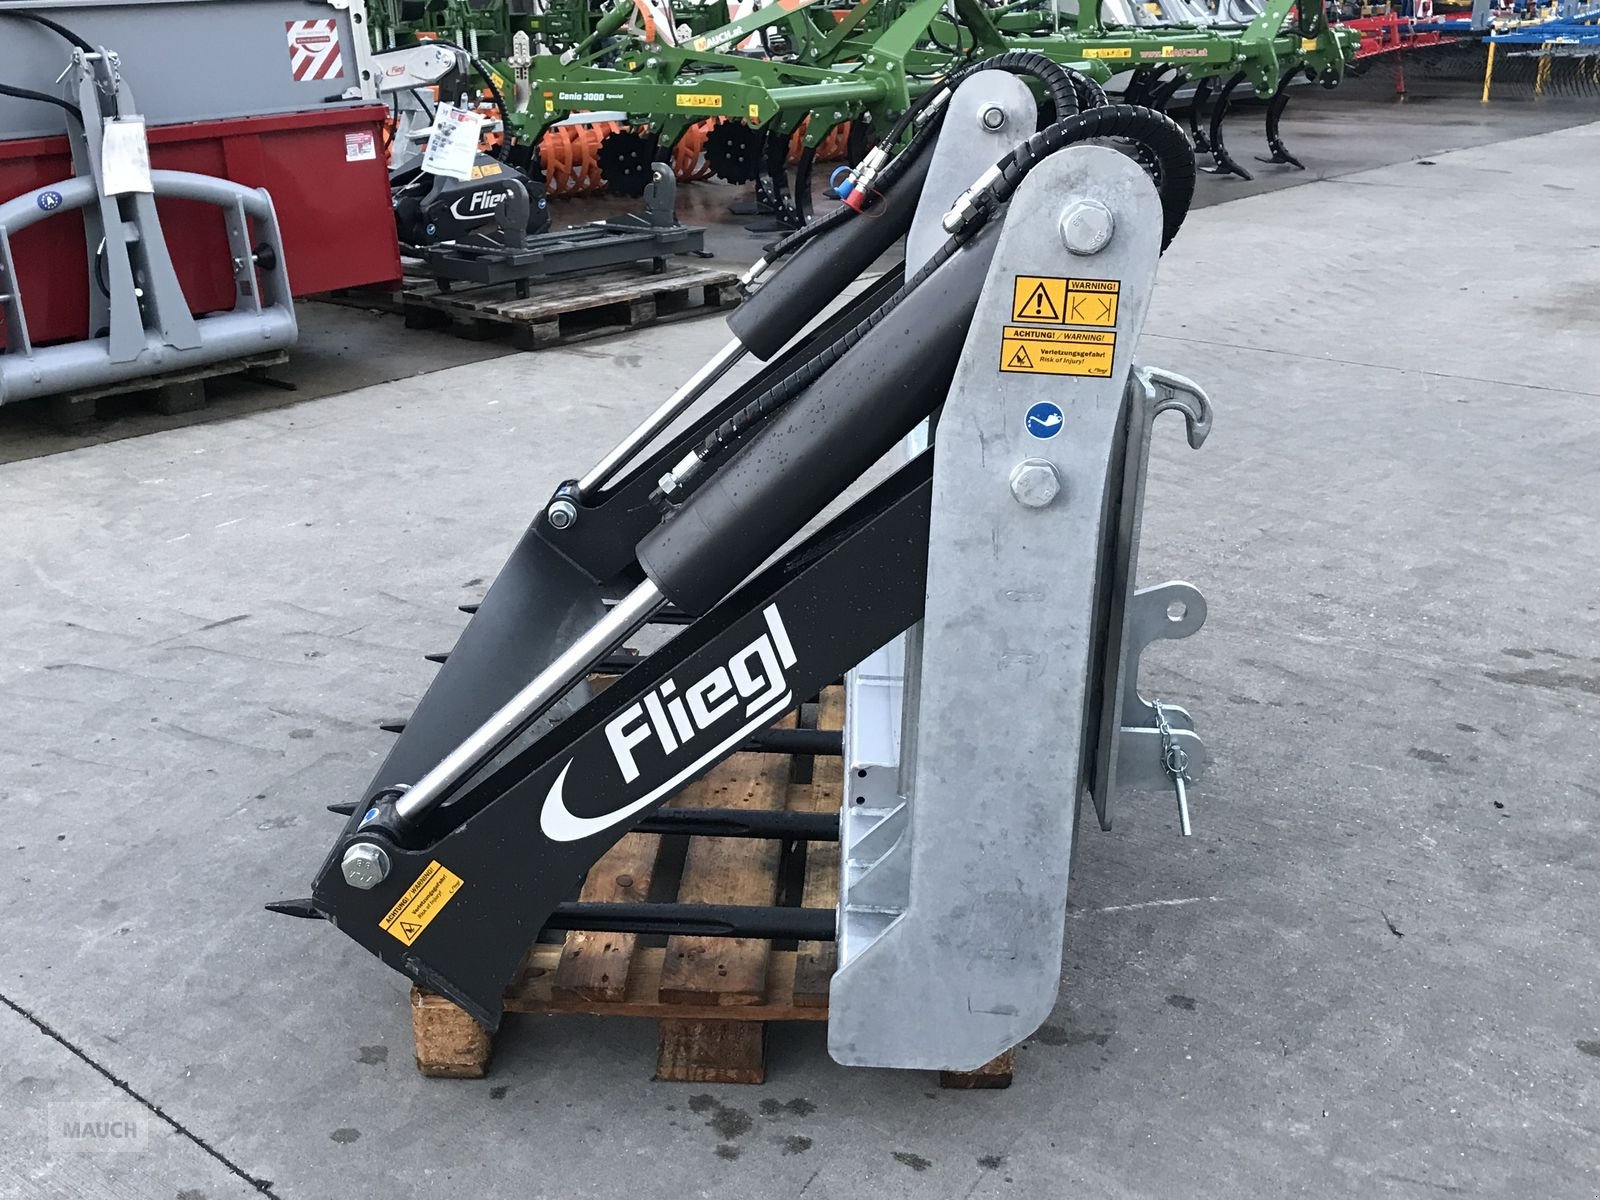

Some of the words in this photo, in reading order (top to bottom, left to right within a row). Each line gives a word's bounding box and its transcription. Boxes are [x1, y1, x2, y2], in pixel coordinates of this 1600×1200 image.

[583, 92, 605, 102] 3000
[1071, 281, 1116, 290] WARNING!
[1013, 330, 1055, 339] ACHTUNG!
[1063, 333, 1105, 341] WARNING!
[1040, 348, 1106, 358] Verletzungsgefahr!
[605, 602, 798, 784] Fliegl
[385, 896, 410, 924] ACHTUNG!
[411, 867, 435, 894] WARNING!
